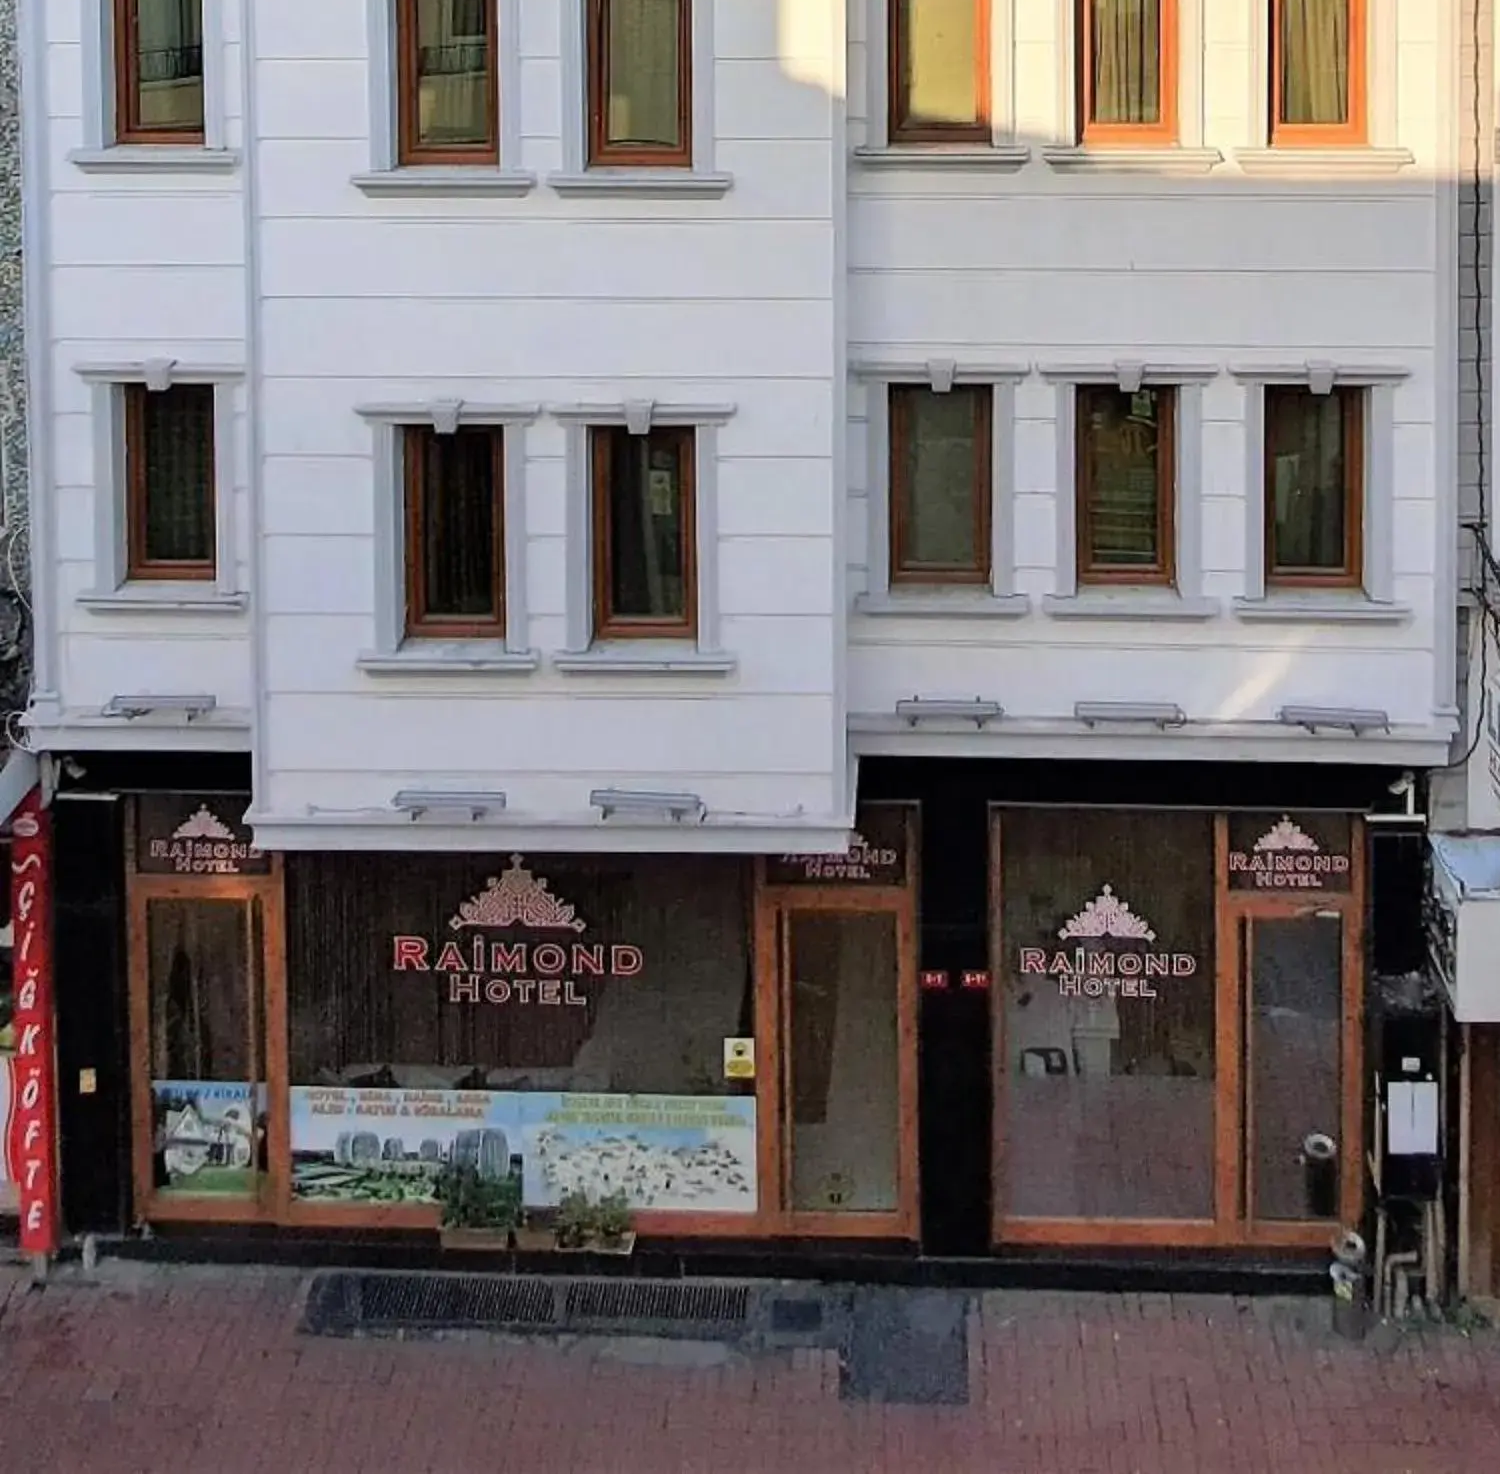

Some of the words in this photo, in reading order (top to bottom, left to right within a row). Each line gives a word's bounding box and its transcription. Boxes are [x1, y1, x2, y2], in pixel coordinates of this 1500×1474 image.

[175, 857, 239, 872] HOTEL
[805, 861, 871, 878] HOTEL
[1255, 871, 1323, 887] HOTEL
[450, 973, 587, 1005] HOTEL
[1059, 974, 1157, 997] HOTEL
